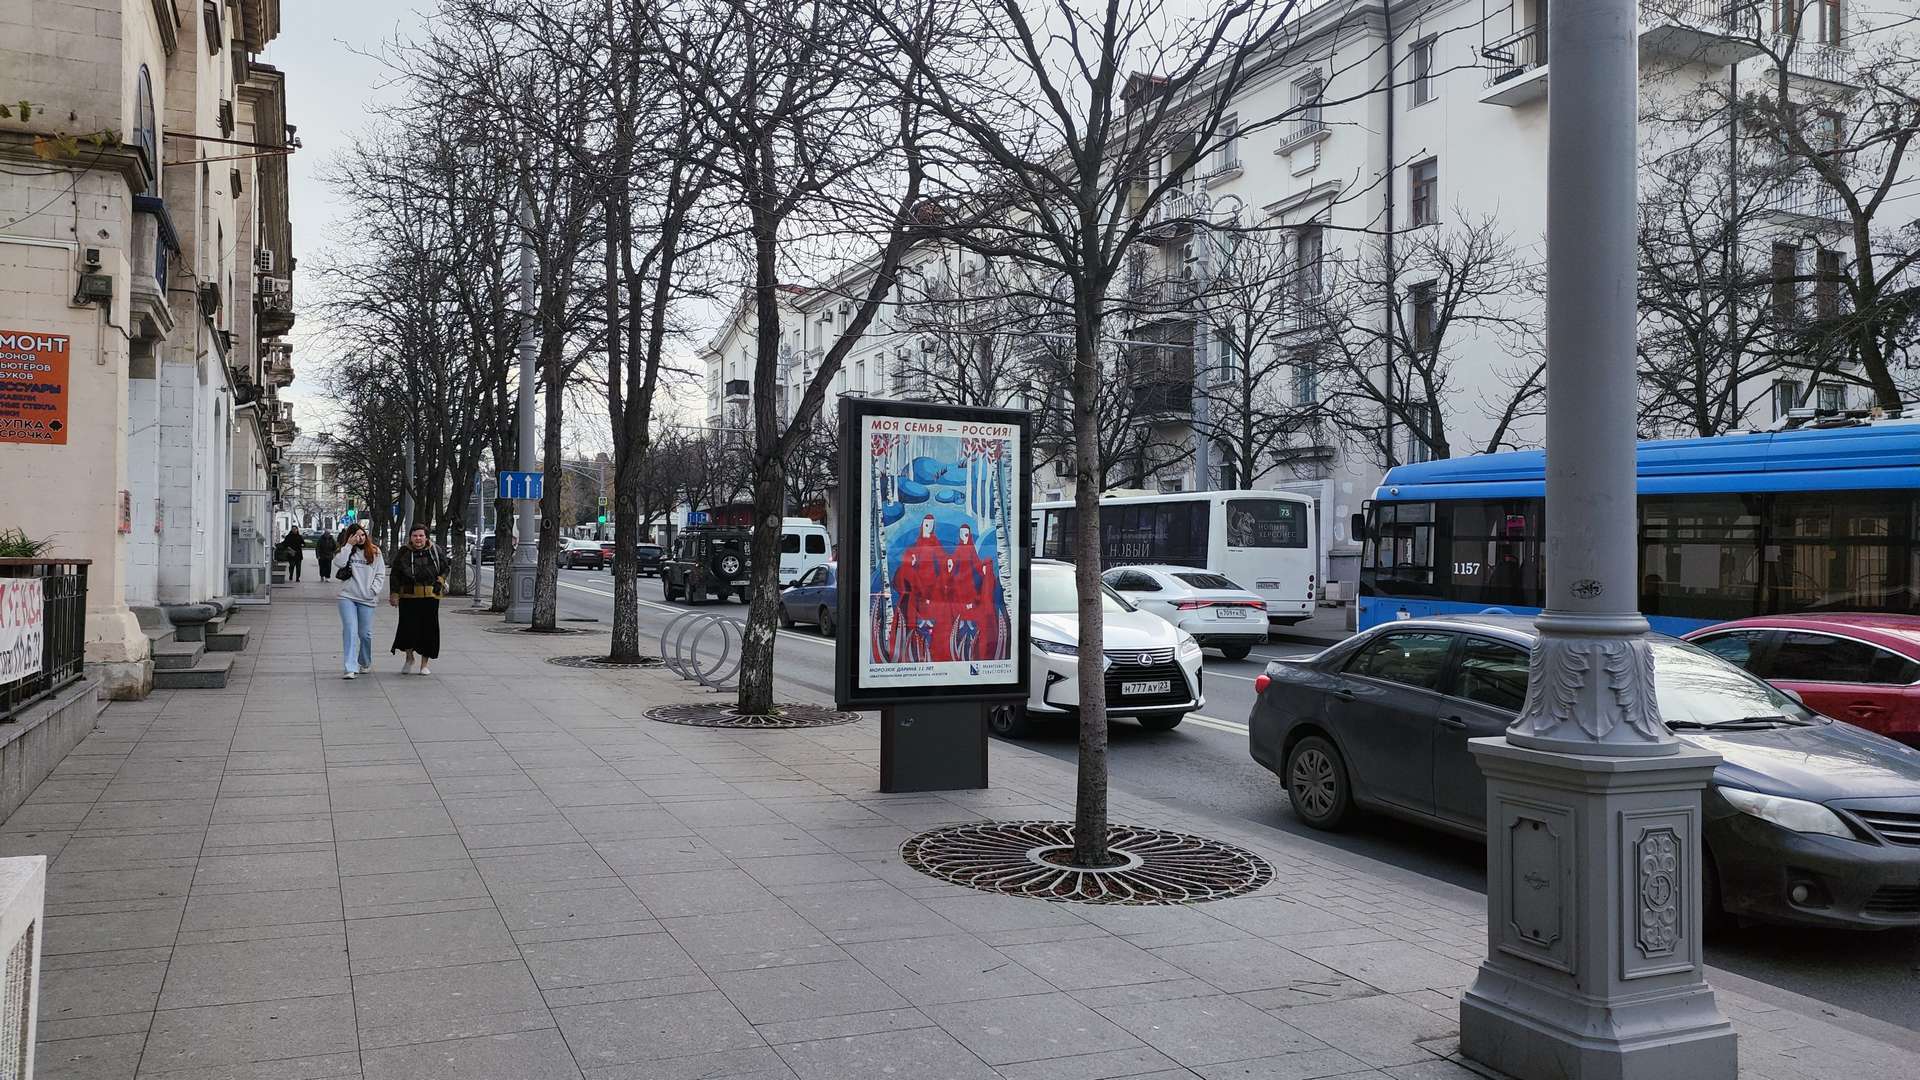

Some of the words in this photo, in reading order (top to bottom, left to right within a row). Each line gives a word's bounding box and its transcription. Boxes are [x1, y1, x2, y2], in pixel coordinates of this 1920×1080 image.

[871, 420, 899, 431] МОЯ
[904, 422, 943, 433] СЕМЬЯ
[961, 425, 1012, 436] РОССИЯ!
[1280, 509, 1290, 517] 73
[1453, 562, 1481, 575] 1157
[1159, 682, 1168, 690] 23
